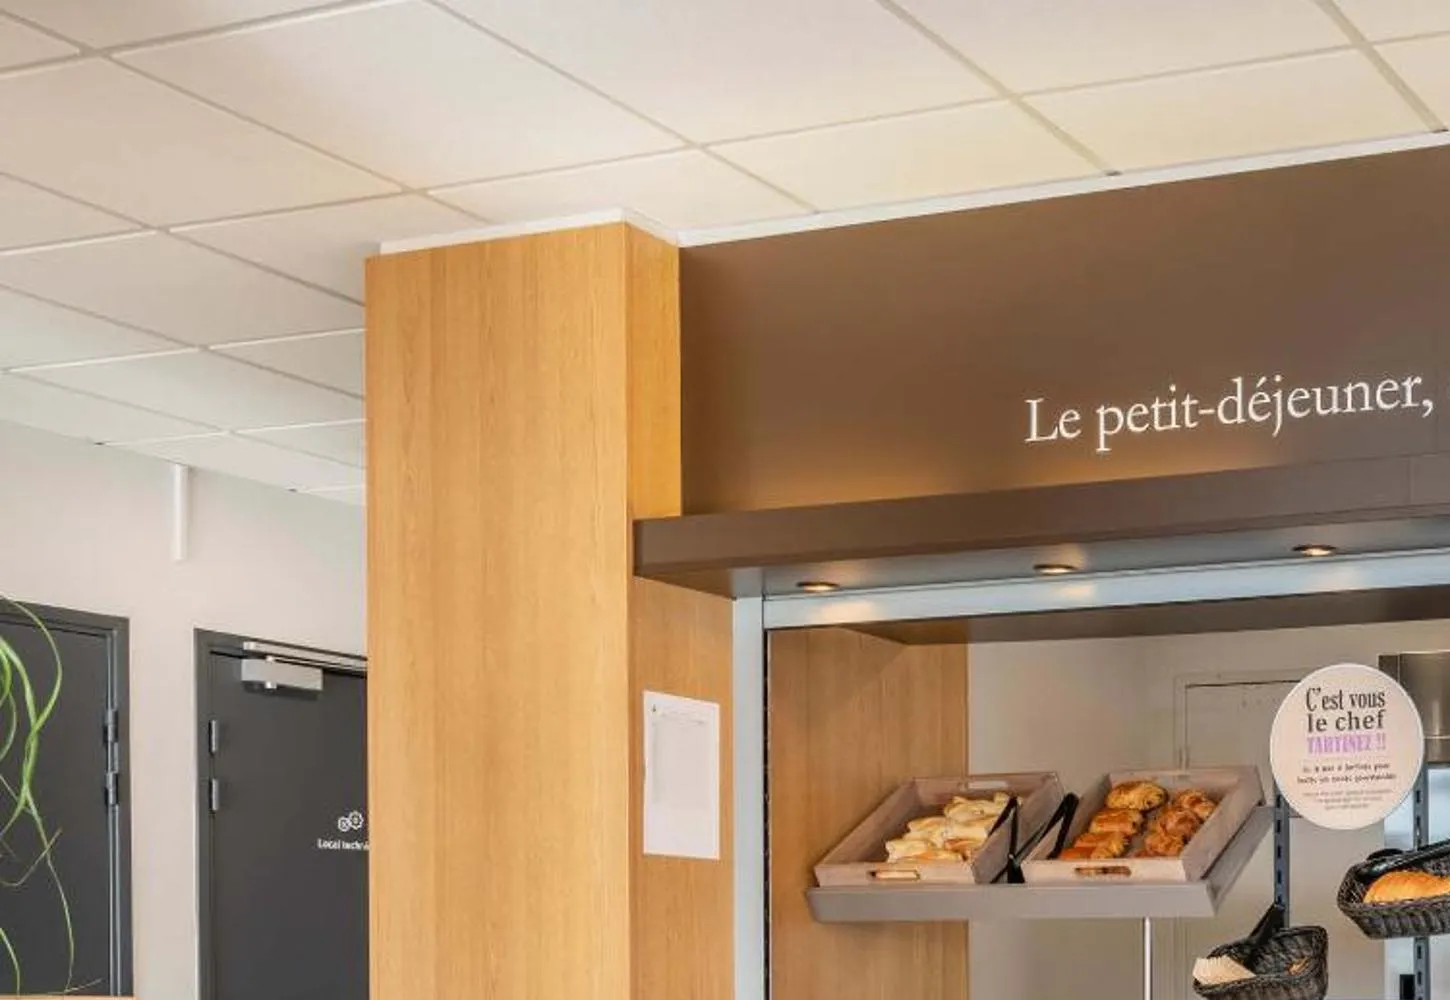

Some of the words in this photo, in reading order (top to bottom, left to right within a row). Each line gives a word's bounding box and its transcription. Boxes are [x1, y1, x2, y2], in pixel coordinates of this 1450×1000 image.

[1026, 399, 1080, 441] Le
[1097, 375, 1432, 451] petit-déjeuner,
[1306, 687, 1344, 712] C'est
[1349, 690, 1386, 710] vous
[1307, 713, 1328, 733] le
[1335, 709, 1386, 732] chef
[317, 838, 341, 849] Local
